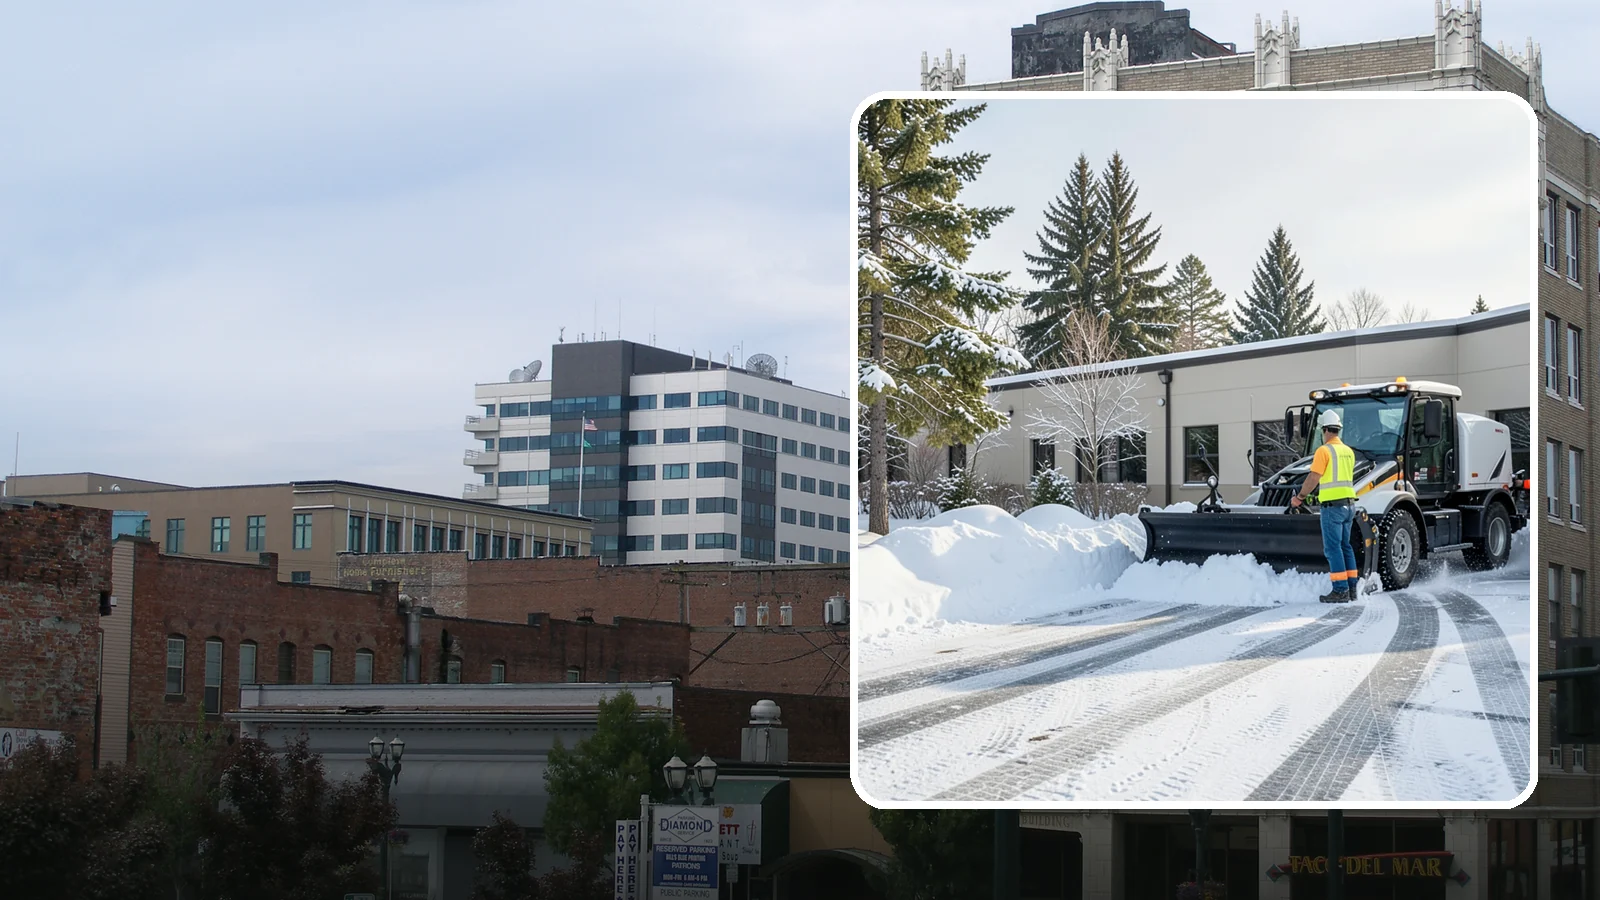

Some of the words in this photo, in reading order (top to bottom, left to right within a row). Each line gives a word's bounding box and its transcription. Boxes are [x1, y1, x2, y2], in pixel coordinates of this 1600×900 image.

[370, 566, 427, 576] Furnishers
[660, 818, 713, 833] DIAMOND
[1022, 815, 1069, 828] BUILDING
[617, 825, 625, 852] PAY
[628, 824, 636, 852] PAY
[656, 845, 688, 853] RESERVED
[689, 846, 716, 854] PARKING
[721, 851, 739, 861] Soup
[671, 862, 701, 870] PATRONS
[1346, 856, 1384, 875] DEL
[1392, 857, 1442, 877] MAR
[617, 856, 625, 894] HERE
[628, 855, 636, 894] HERE
[660, 888, 682, 897] PUBLIC
[684, 890, 710, 898] PARKING
